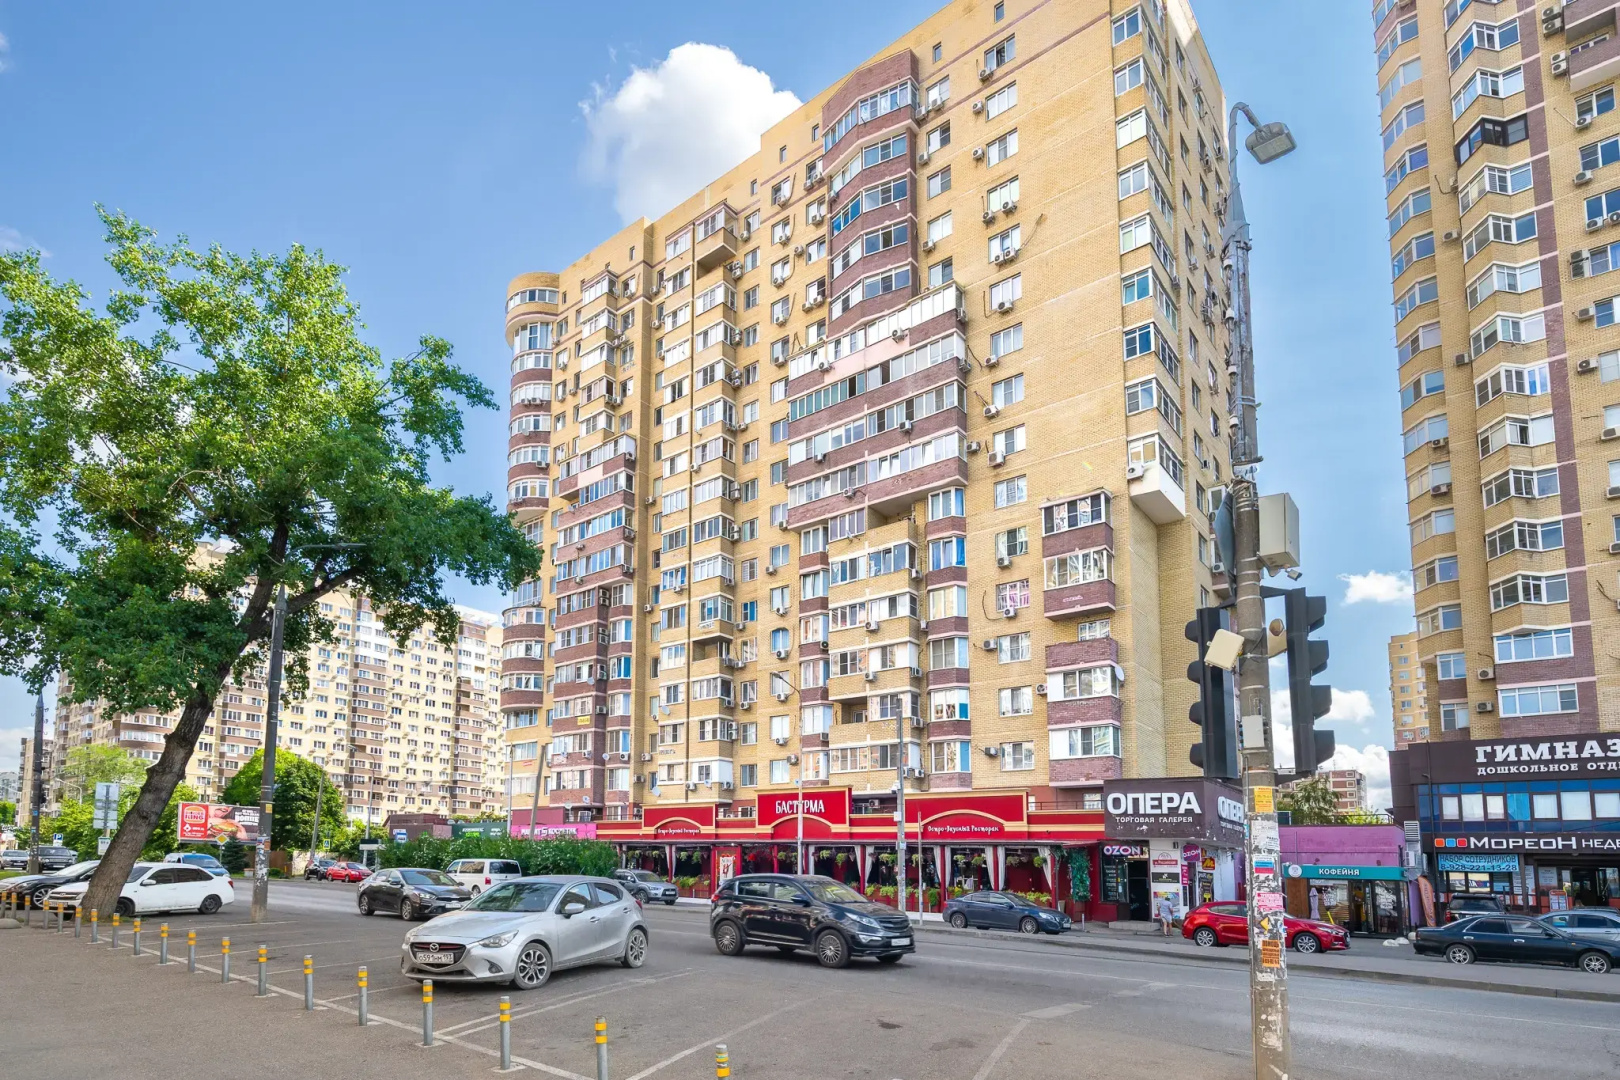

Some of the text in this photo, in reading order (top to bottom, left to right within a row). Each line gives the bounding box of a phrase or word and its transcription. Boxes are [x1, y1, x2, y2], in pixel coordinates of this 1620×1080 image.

[1475, 739, 1620, 763] ГИМНАЗ
[1477, 761, 1620, 776] ДОШКОЛЬНОЕ ОТД
[1106, 791, 1202, 815] ОПЕРА
[1217, 796, 1244, 823] ОПЕР
[1103, 845, 1140, 856] OZON
[1182, 849, 1200, 858] OZON
[1439, 855, 1517, 864] НАБОР СОТРУДНИКОВ
[1318, 867, 1360, 876] КОФЕЙНЯ
[1440, 863, 1518, 871] 8-928-221-13-28
